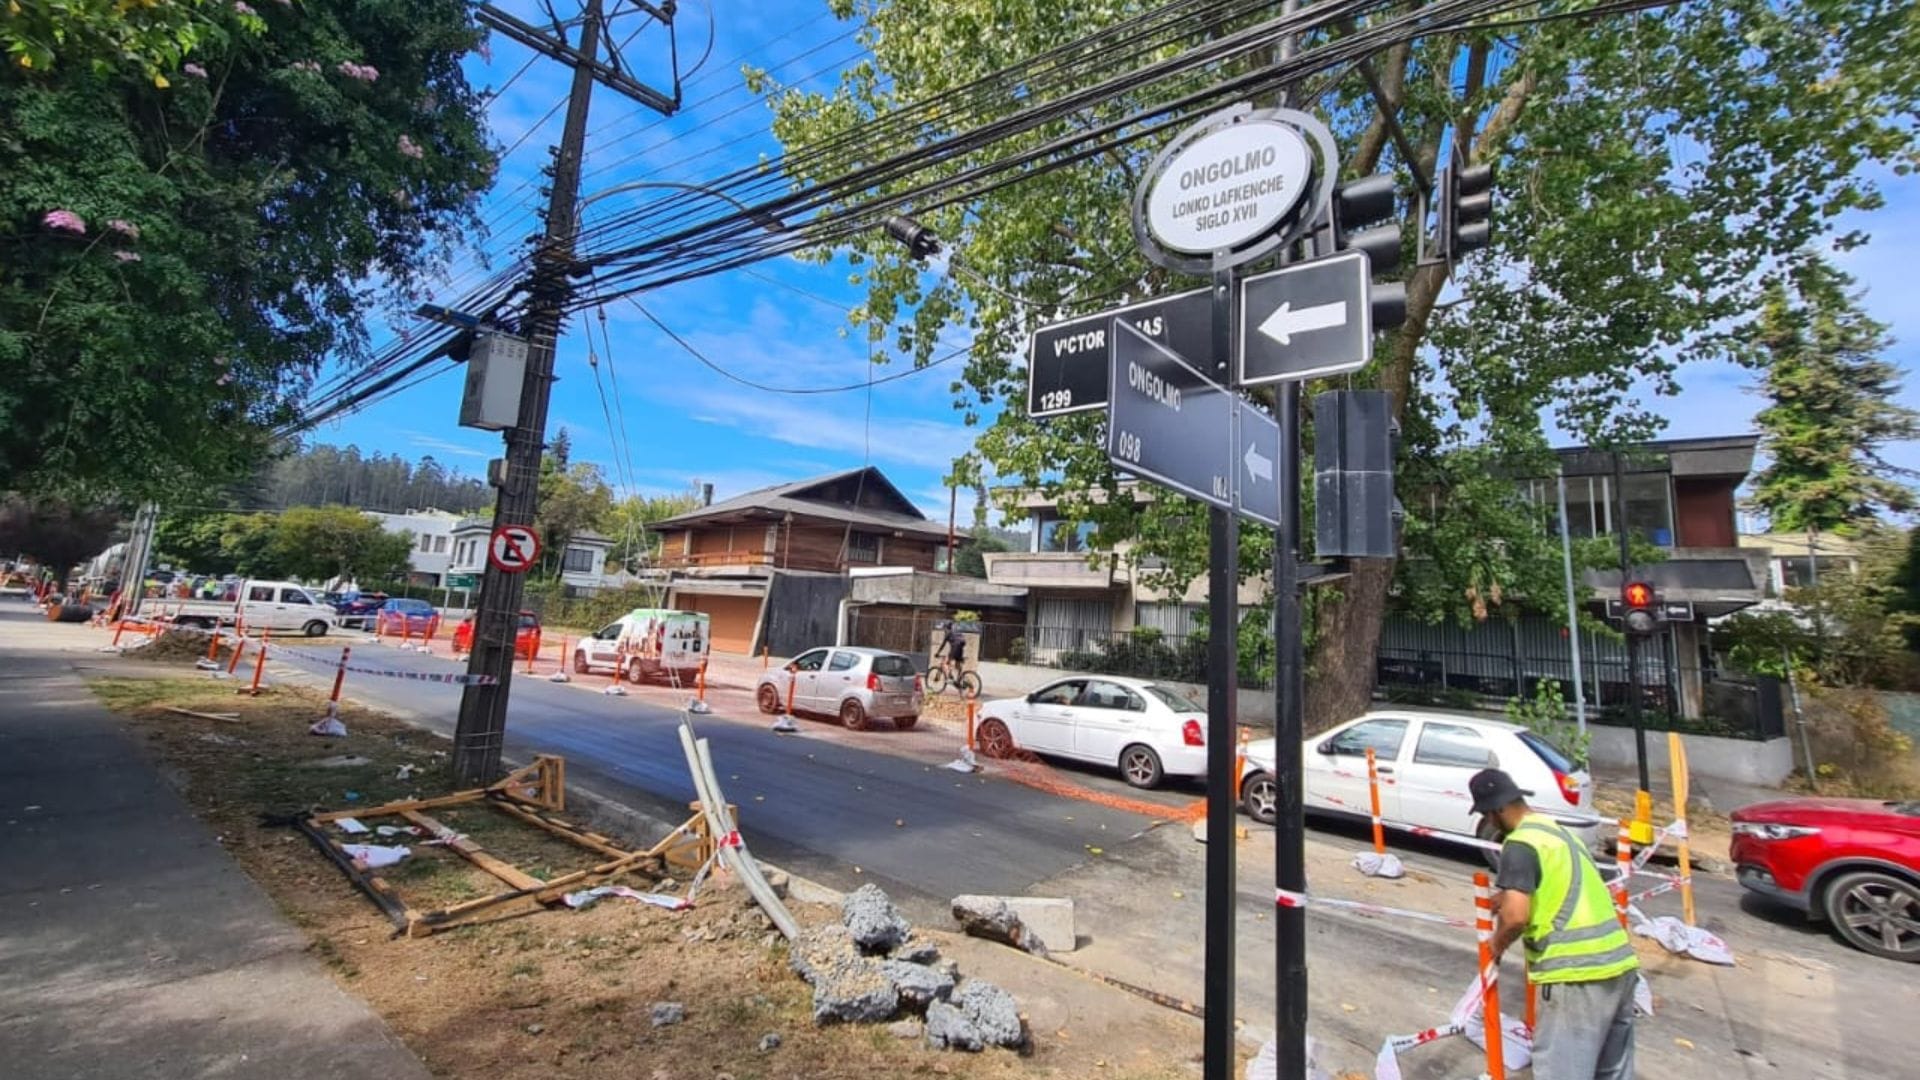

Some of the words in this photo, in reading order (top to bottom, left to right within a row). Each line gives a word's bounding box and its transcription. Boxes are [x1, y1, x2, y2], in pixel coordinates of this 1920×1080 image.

[1180, 146, 1275, 190] ONGOLMO
[1173, 196, 1210, 218] LONKO
[1213, 175, 1284, 208] LAFKENCHE
[1196, 210, 1229, 231] SIGLO
[1233, 203, 1258, 222] XVII
[1054, 330, 1105, 357] VICTOR
[1040, 389, 1072, 410] 1299
[1128, 361, 1181, 412] ONGOLMO
[1119, 431, 1141, 462] 098
